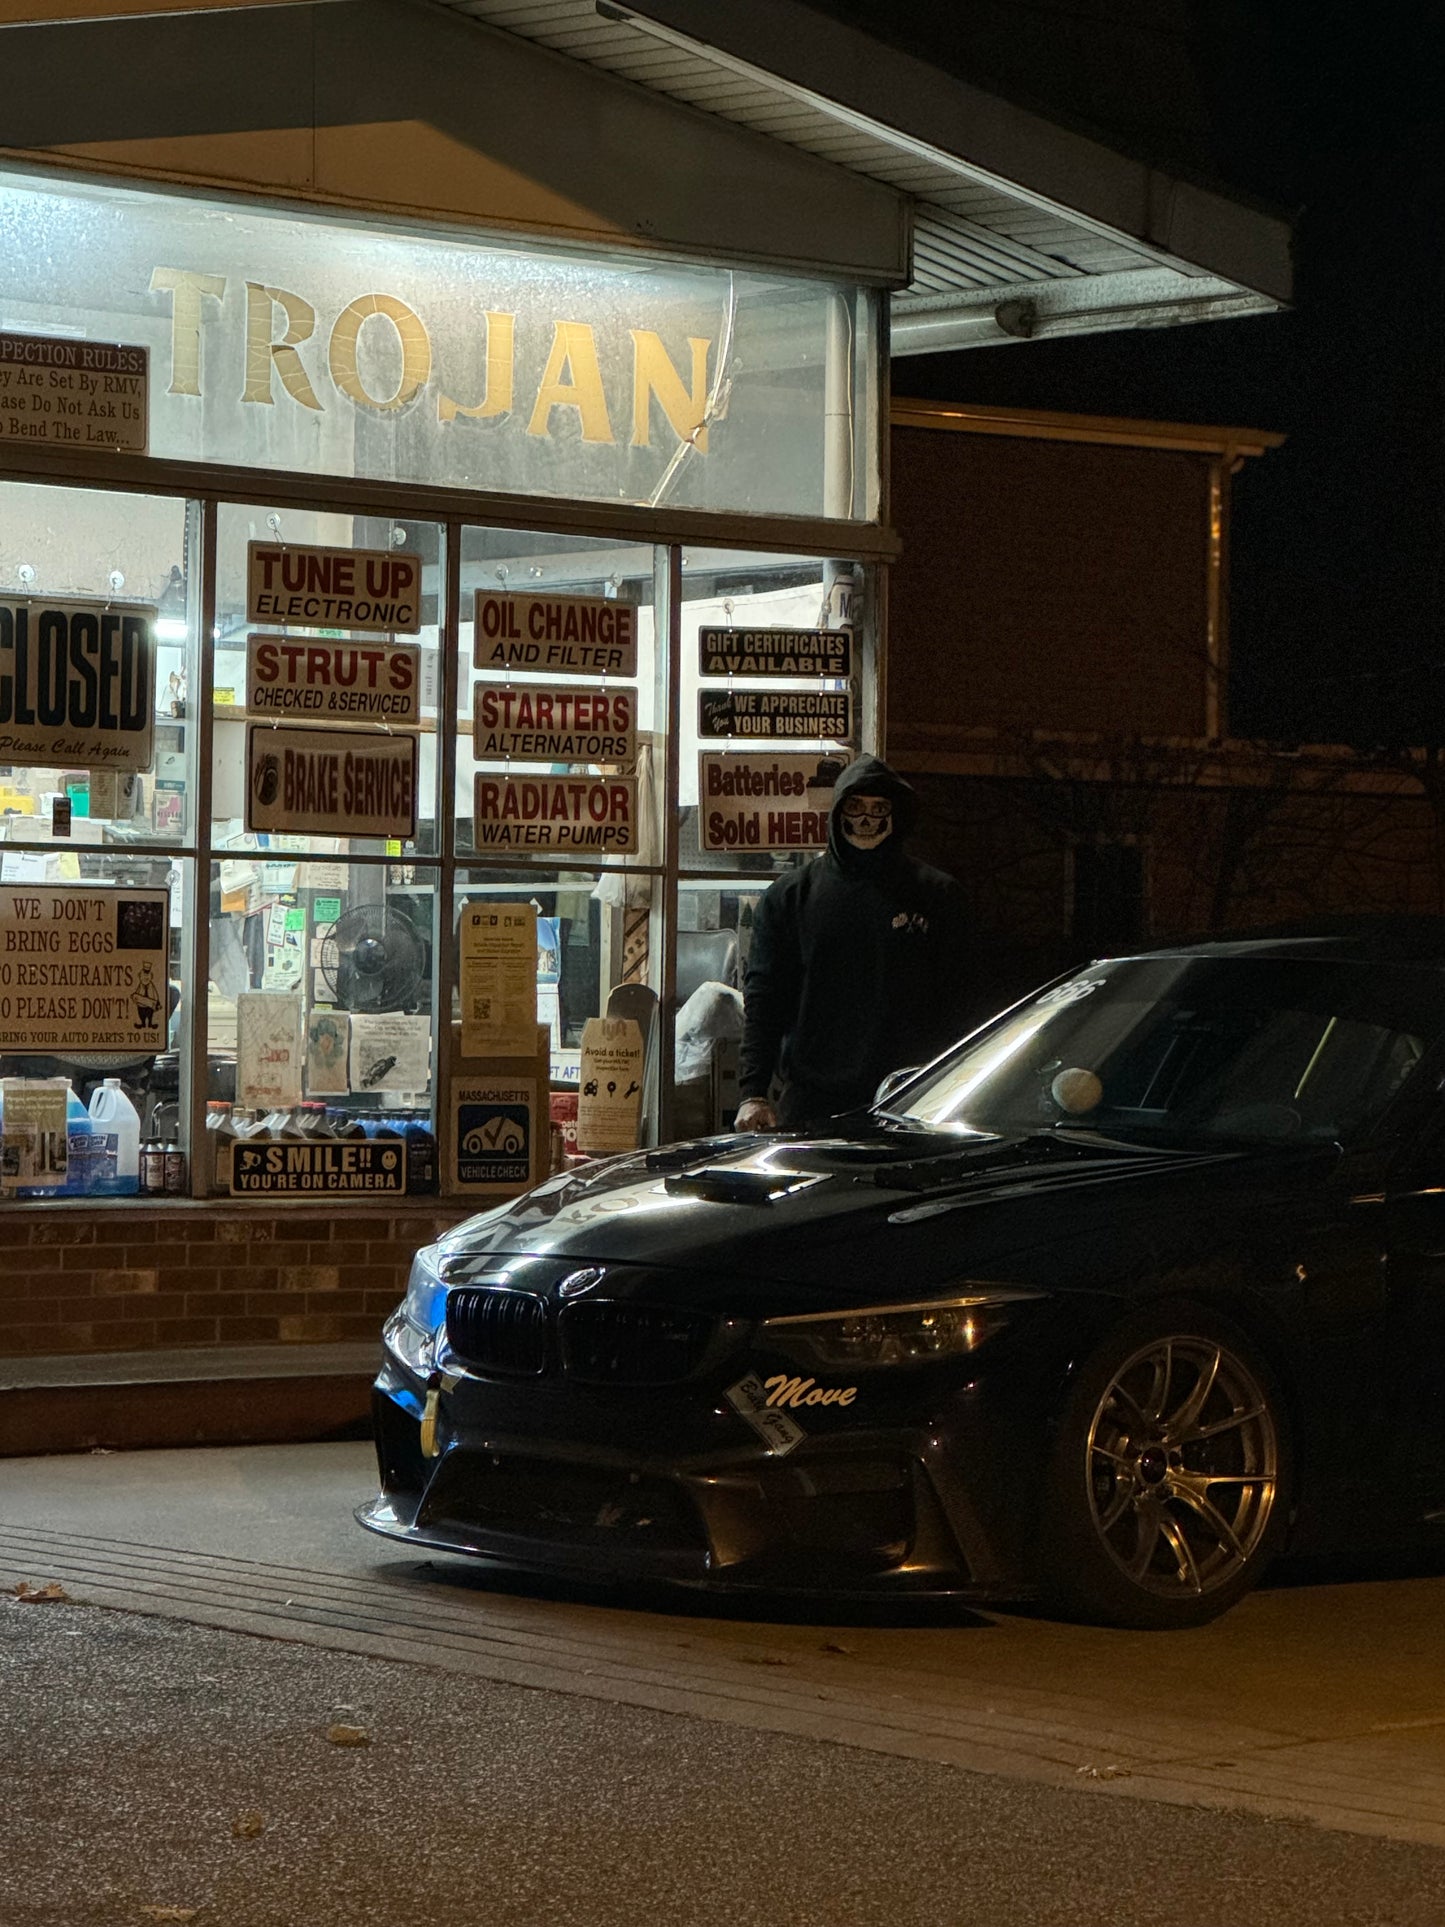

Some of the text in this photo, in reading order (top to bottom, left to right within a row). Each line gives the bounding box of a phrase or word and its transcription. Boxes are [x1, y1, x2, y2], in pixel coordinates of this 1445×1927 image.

[82, 348, 143, 372] RULES:
[148, 266, 712, 455] TROJAN
[17, 368, 43, 386] Are
[49, 370, 74, 389] Set
[79, 374, 98, 396] By
[103, 375, 141, 398] RMV,
[32, 394, 51, 412] Do
[57, 397, 83, 415] Not
[87, 400, 116, 418] Ask
[122, 402, 139, 420] Us
[9, 417, 47, 437] Bend
[52, 421, 80, 439] The
[256, 552, 414, 599] TUNE UP
[256, 594, 413, 624] ELECTRONIC
[482, 600, 631, 645] OIL CHANGE
[490, 643, 623, 668] AND FILTER
[707, 633, 844, 656] GIFT CERTIFICATES
[256, 644, 413, 691] STRUTS
[708, 656, 843, 673] AVAILABLE
[254, 686, 323, 710] CHECKED
[735, 696, 844, 714] WE APPRECIATE
[482, 690, 630, 733] STARTERS
[734, 716, 845, 735] YOUR BUSINESS
[0, 736, 130, 760] Please Call Again
[485, 733, 627, 755] ALTERNATORS
[283, 749, 411, 819] BRAKE SERVICE
[707, 763, 805, 797] Batteries
[481, 782, 629, 822] RADIATOR
[482, 824, 629, 845] WATER PUMPS
[708, 811, 760, 845] Sold
[12, 898, 105, 921] WE DON'T
[6, 930, 114, 953] BRING EGGS
[17, 964, 133, 987] RESTAURANTS
[16, 998, 77, 1019] PLEASE
[82, 998, 130, 1020] DON'T!
[0, 1032, 160, 1044] RING YOUR AUTO PARTS TO US!
[585, 1047, 607, 1057] Avoid
[616, 1048, 640, 1058] ticket!
[459, 1090, 529, 1102] MASSACHUSETTS
[266, 1146, 372, 1173] SMILE!!
[240, 1174, 396, 1188] YOU'RE ON CAMERA
[460, 1165, 527, 1179] VEHICLE CHECK
[764, 1374, 857, 1408] Move
